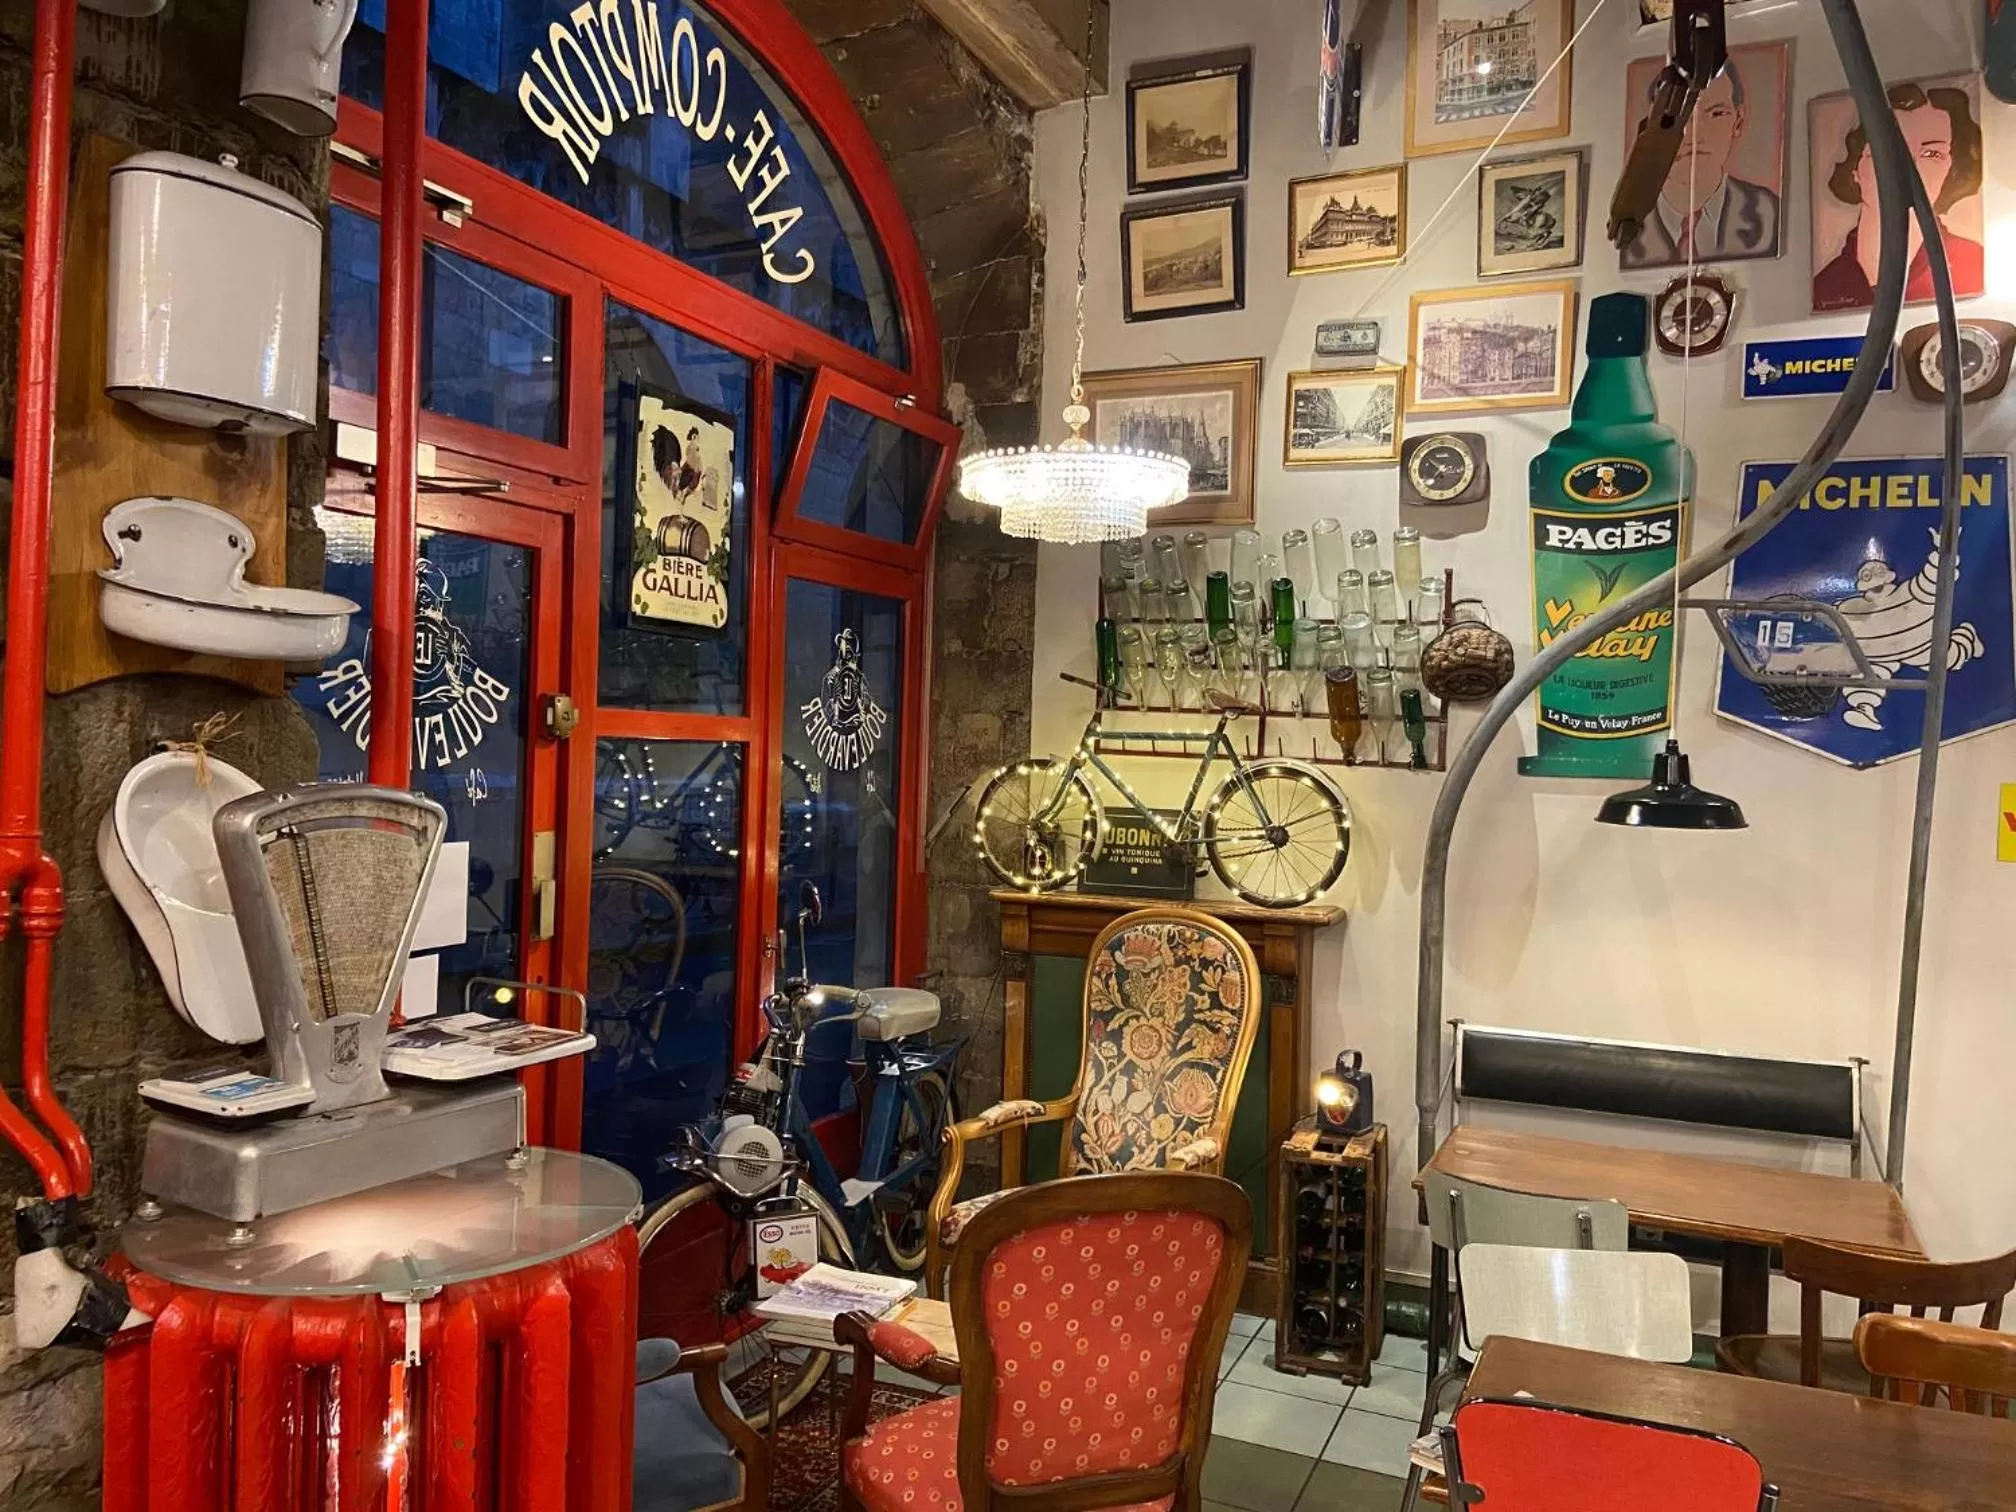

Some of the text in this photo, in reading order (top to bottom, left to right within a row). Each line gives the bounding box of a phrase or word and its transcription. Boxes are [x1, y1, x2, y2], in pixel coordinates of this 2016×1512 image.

[784, 352, 889, 375] MICHE
[1757, 474, 1992, 511] MCHELN
[663, 557, 703, 580] BIÈRE
[642, 568, 719, 605] GALLIA
[1544, 598, 1673, 632] Veine
[1539, 627, 1658, 661] lay
[1104, 827, 1167, 847] UBONN
[1121, 856, 1163, 865] QUINQUINA
[1127, 848, 1161, 857] TONIQUE
